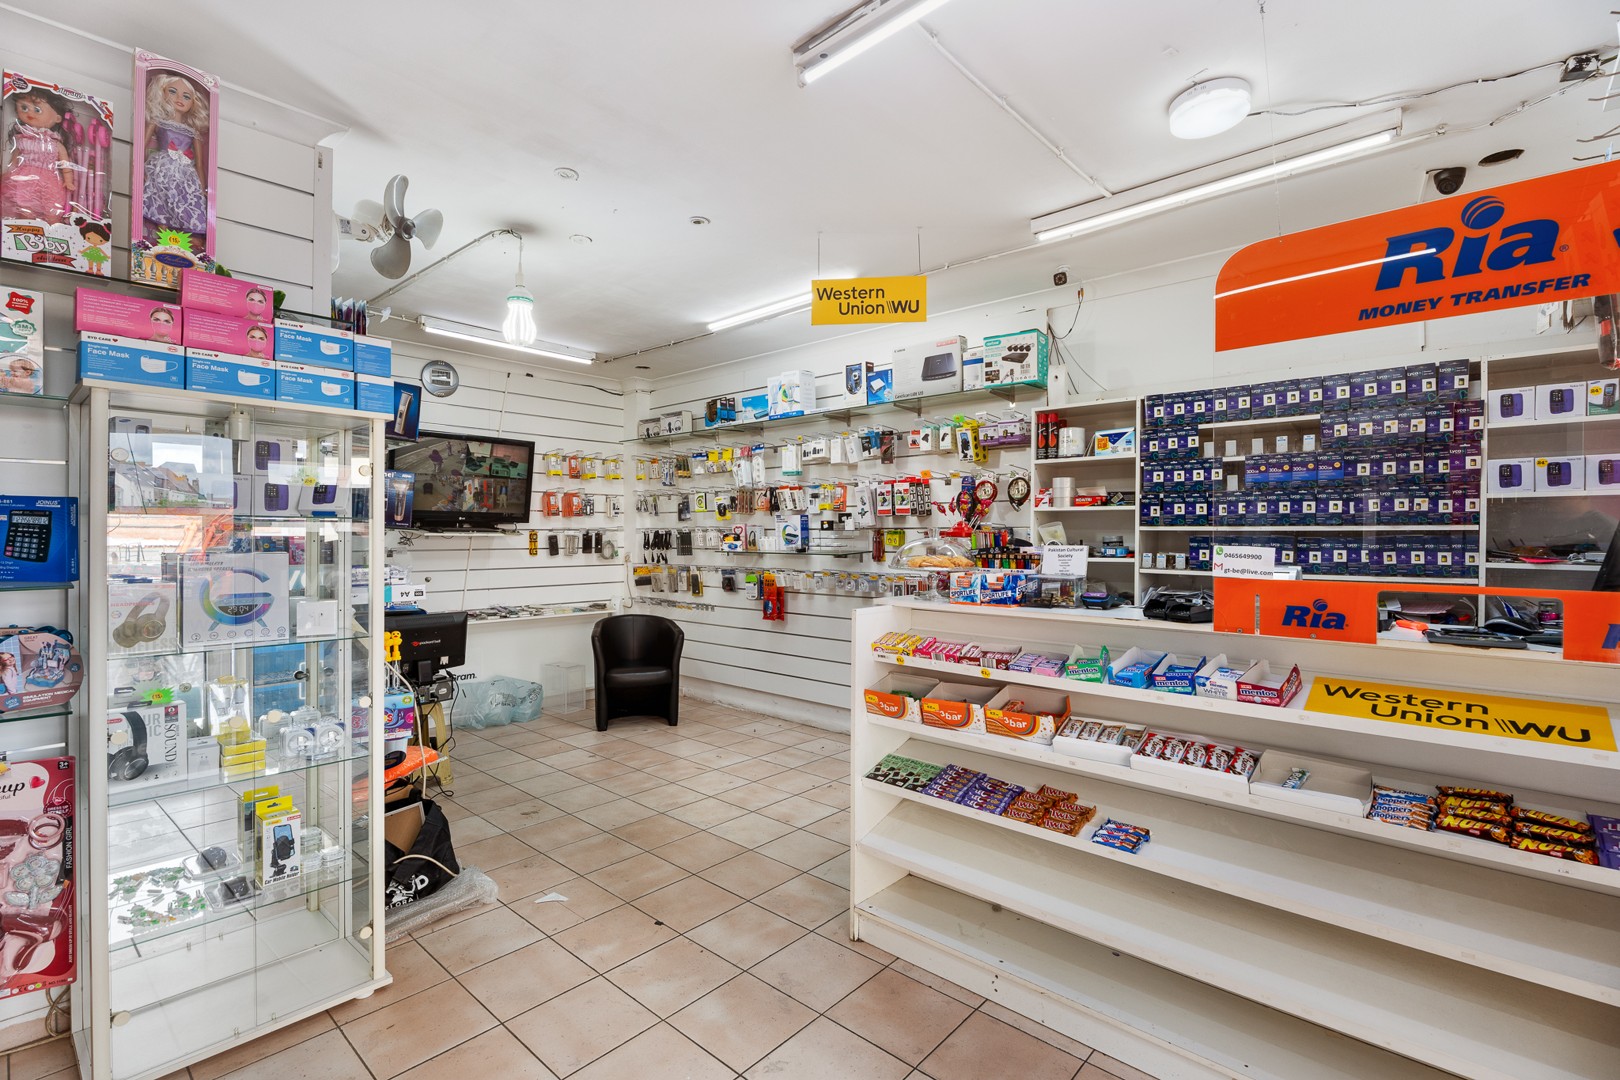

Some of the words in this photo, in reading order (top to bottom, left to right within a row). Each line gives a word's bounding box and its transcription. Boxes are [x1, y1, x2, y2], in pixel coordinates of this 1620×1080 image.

[1375, 195, 1560, 291] Ria
[816, 287, 885, 301] Western
[1358, 297, 1443, 321] MONEY
[1452, 273, 1591, 306] TRANSFER
[839, 300, 885, 315] Union
[296, 335, 313, 343] Mask
[87, 347, 107, 356] Face
[109, 350, 130, 359] Mask
[211, 365, 229, 373] Mask
[1224, 567, 1274, 576] gt-be@live.com
[951, 589, 976, 597] SPORTLIFE
[982, 591, 1009, 600] SPORTLIFE
[1281, 598, 1346, 630] Ria
[1068, 667, 1099, 675] mentos
[1156, 679, 1190, 687] mentos
[1240, 688, 1278, 698] mentos
[1323, 683, 1489, 715] Western
[1370, 703, 1489, 731] Union
[164, 723, 178, 762] SOUND
[1371, 804, 1412, 813] Knoppers
[1369, 811, 1410, 821] Knoppers
